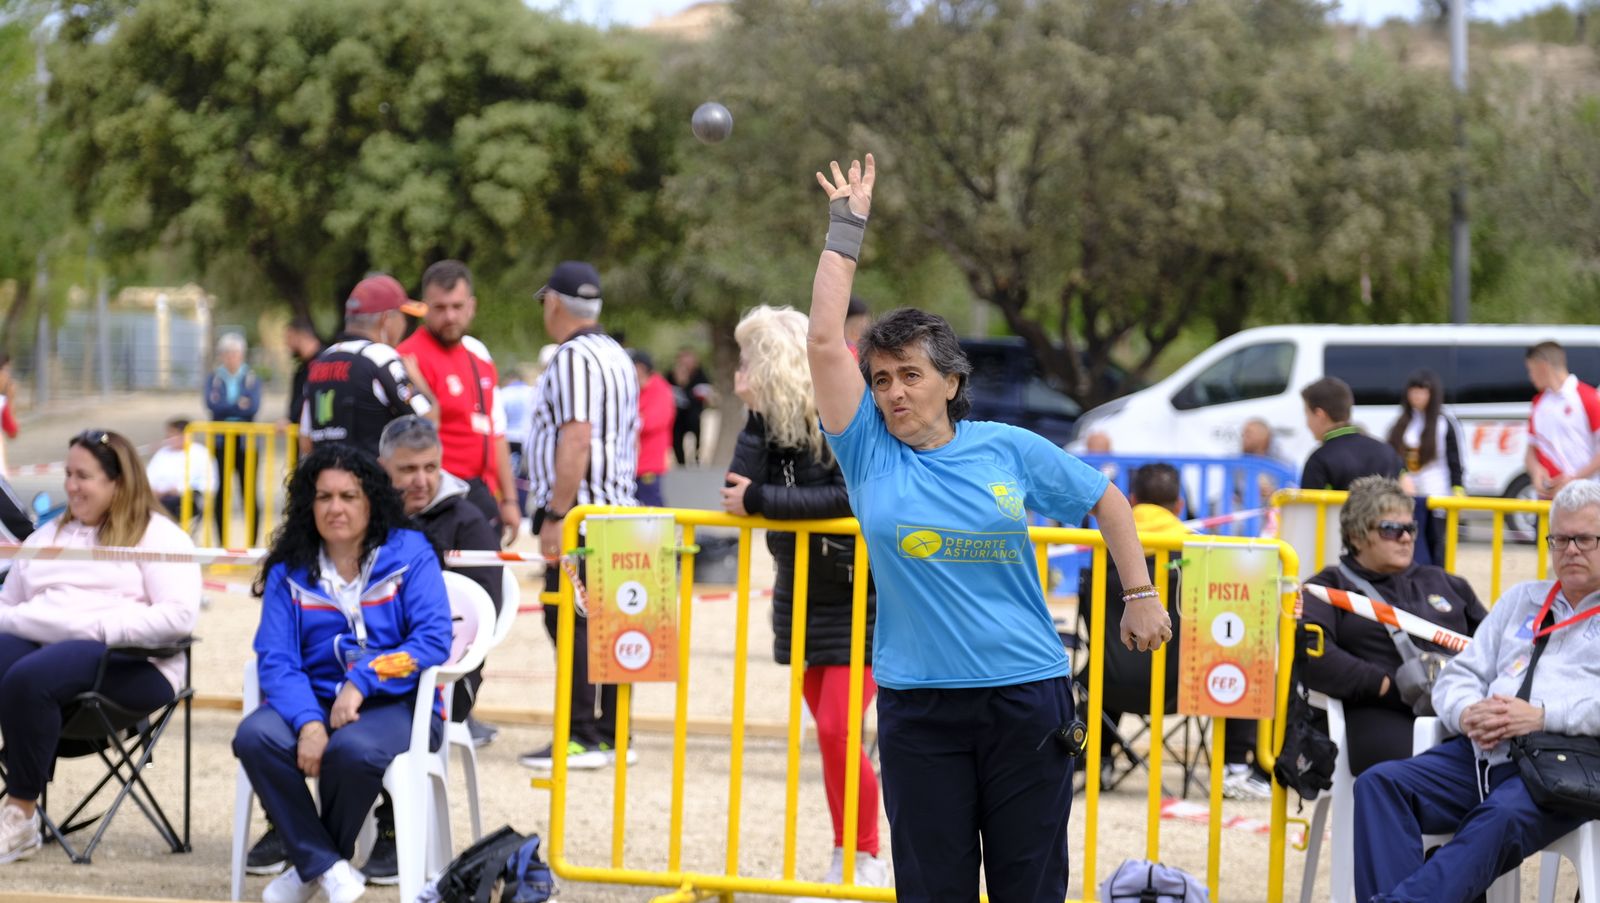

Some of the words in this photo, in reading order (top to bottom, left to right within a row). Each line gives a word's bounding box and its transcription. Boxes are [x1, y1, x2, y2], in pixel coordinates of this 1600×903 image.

[945, 537, 1008, 550] DEPORTE
[611, 552, 651, 570] PISTA
[943, 548, 1018, 559] ASTURIANO
[627, 588, 638, 606] 2
[1208, 582, 1250, 601] PISTA
[1225, 620, 1233, 638] 1
